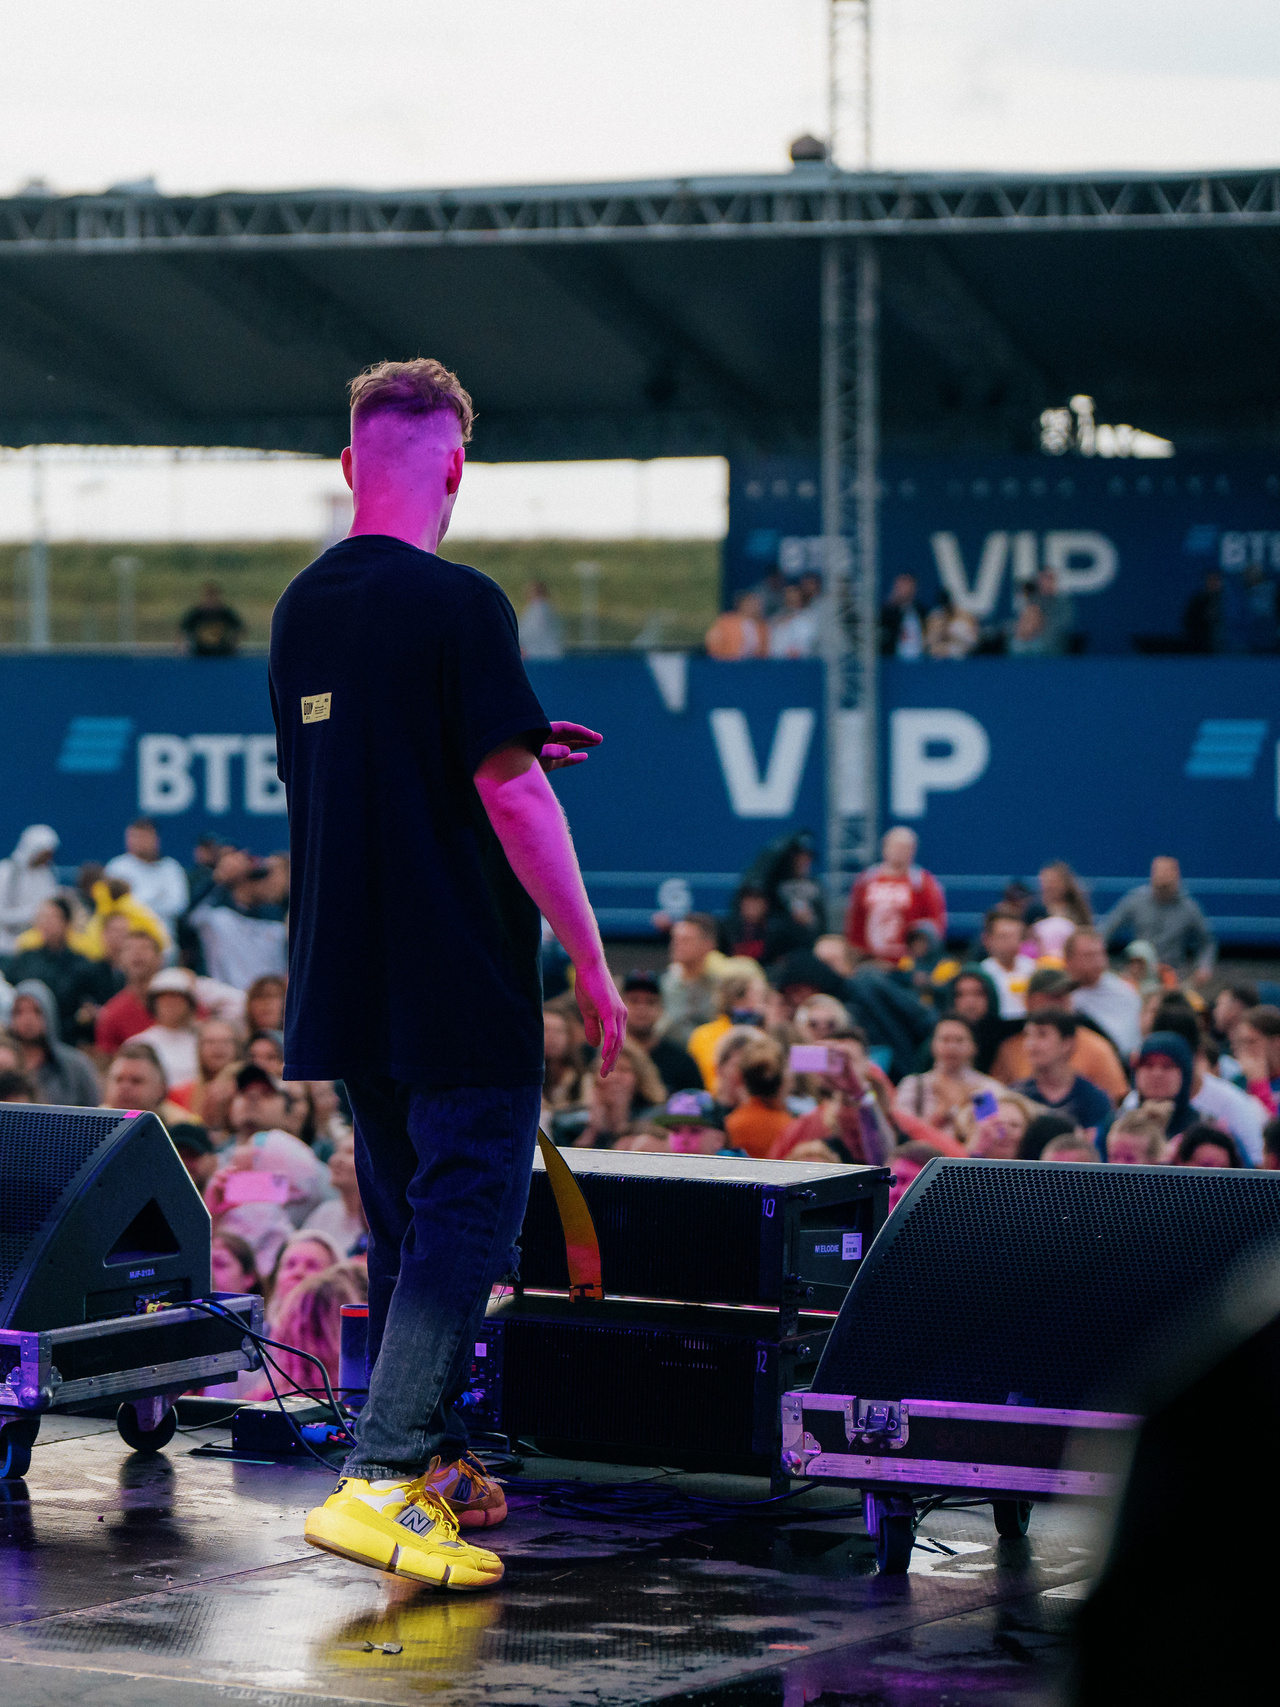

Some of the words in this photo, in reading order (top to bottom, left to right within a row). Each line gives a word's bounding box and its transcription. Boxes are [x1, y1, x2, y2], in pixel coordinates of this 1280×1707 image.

[930, 529, 1120, 617] VIP
[709, 706, 991, 820] VIP
[762, 1198, 776, 1219] 10
[814, 1243, 841, 1254] MELODIE
[756, 1350, 768, 1374] 12
[455, 1478, 470, 1500] N
[400, 1509, 431, 1533] N
